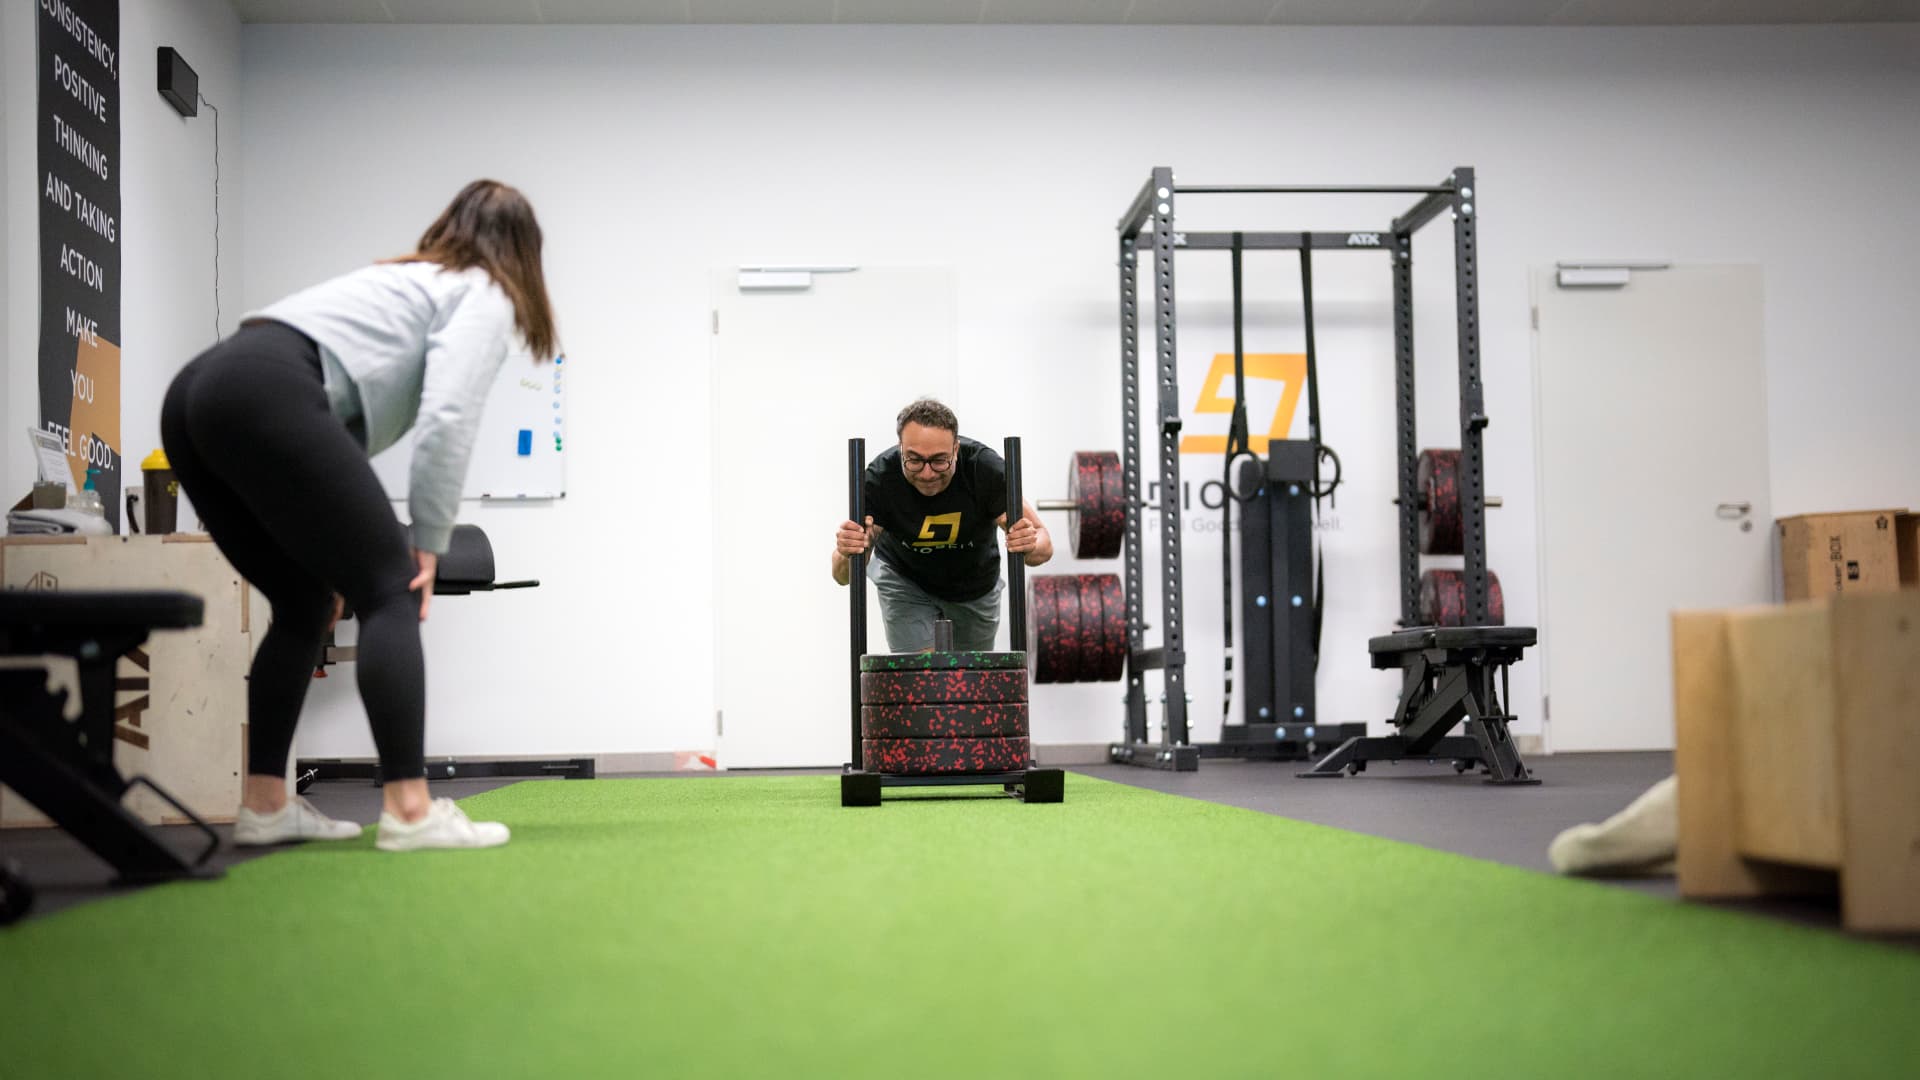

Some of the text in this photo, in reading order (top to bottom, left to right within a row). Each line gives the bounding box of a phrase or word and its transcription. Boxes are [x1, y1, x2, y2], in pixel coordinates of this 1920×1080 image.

[55, 54, 106, 123] POSITIVE
[53, 114, 108, 181] THINKING
[46, 172, 115, 243] AND TAKING
[1347, 233, 1380, 246] ATX
[60, 244, 103, 293] ACTION
[66, 306, 98, 348] MAKE
[70, 369, 94, 404] YOU
[80, 433, 113, 471] GOOD.
